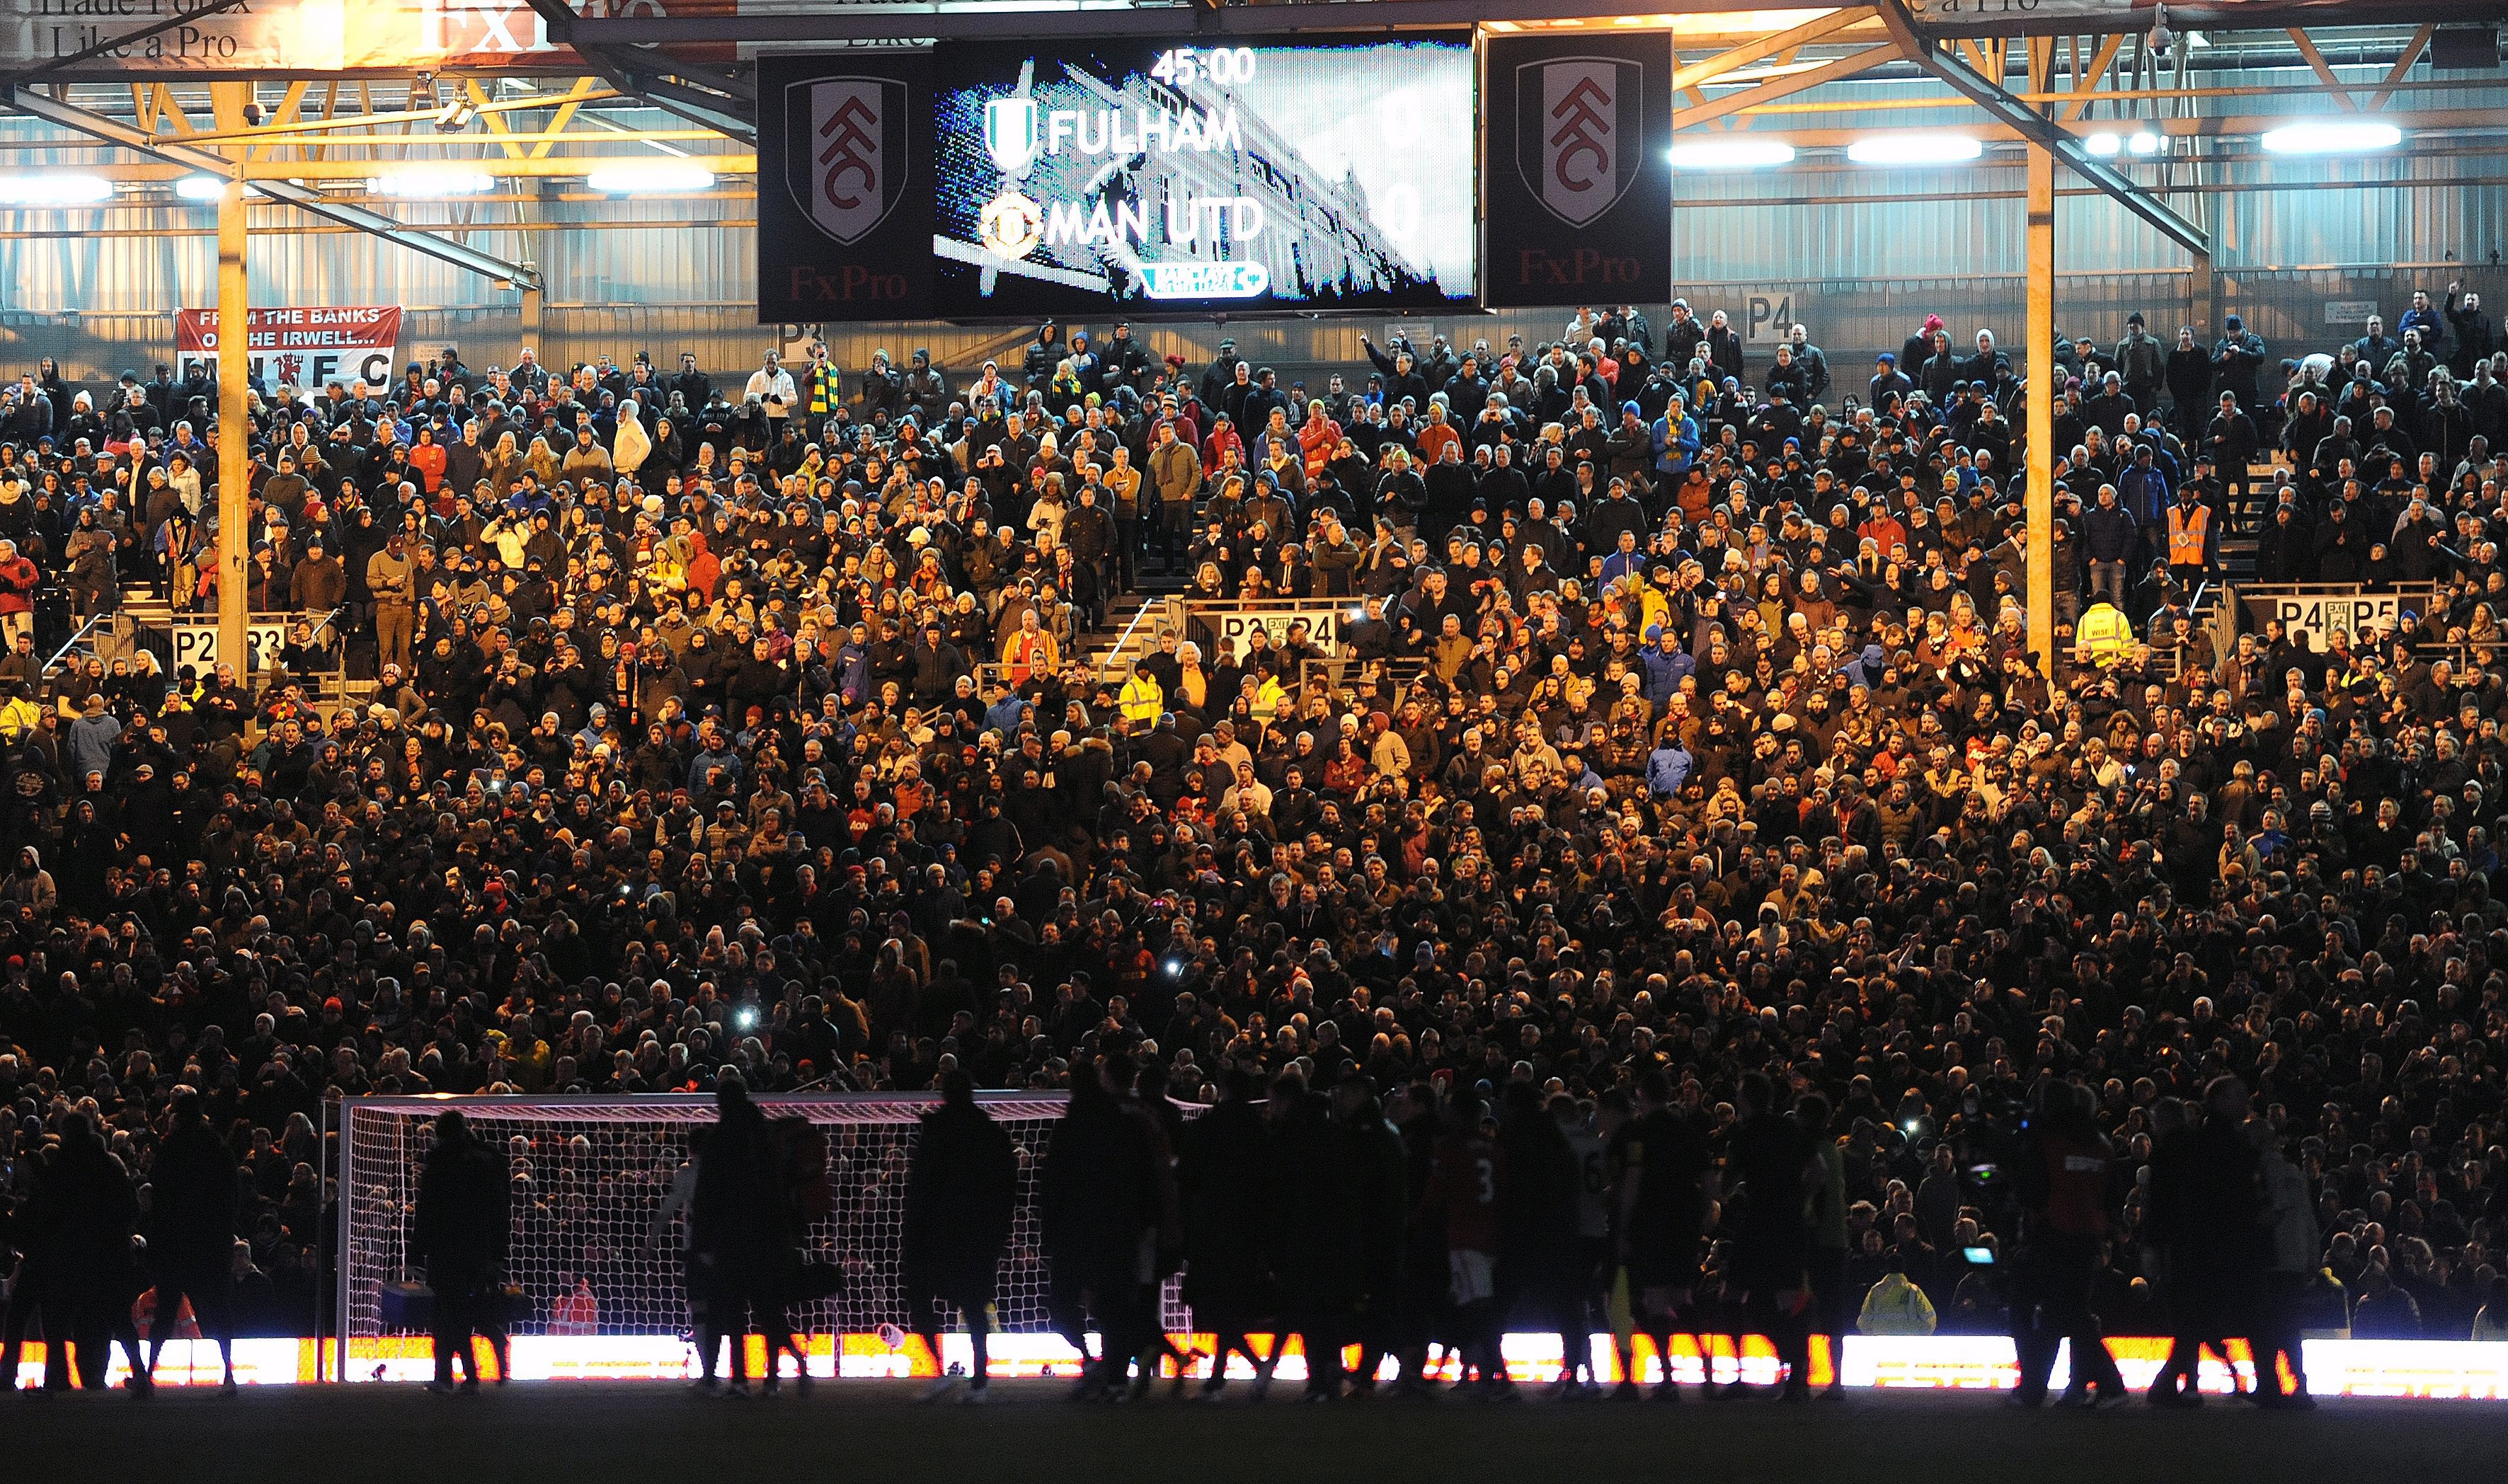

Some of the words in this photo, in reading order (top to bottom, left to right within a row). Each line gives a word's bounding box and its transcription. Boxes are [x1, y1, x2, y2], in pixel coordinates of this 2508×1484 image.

[50, 25, 132, 58] Like
[145, 36, 164, 58] a
[177, 26, 237, 57] Pro
[1150, 47, 1256, 86] 45:00
[1048, 106, 1242, 154] FULHAM
[1046, 199, 1148, 245] MAN
[1167, 197, 1264, 243] UTD
[789, 265, 907, 301] FxPro
[1521, 248, 1641, 284] FxPro
[200, 311, 256, 326] FRM
[264, 310, 304, 325] THE
[310, 309, 379, 324] BANKS
[1749, 297, 1792, 338] P4
[248, 332, 275, 347] HE
[282, 330, 375, 346] IRWELL...
[1268, 619, 1288, 629] EXIT
[2282, 602, 2323, 633] P4
[2327, 603, 2349, 613] EXIT
[177, 631, 214, 662] P2
[849, 820, 869, 831] AON
[1476, 1158, 1494, 1203] 3
